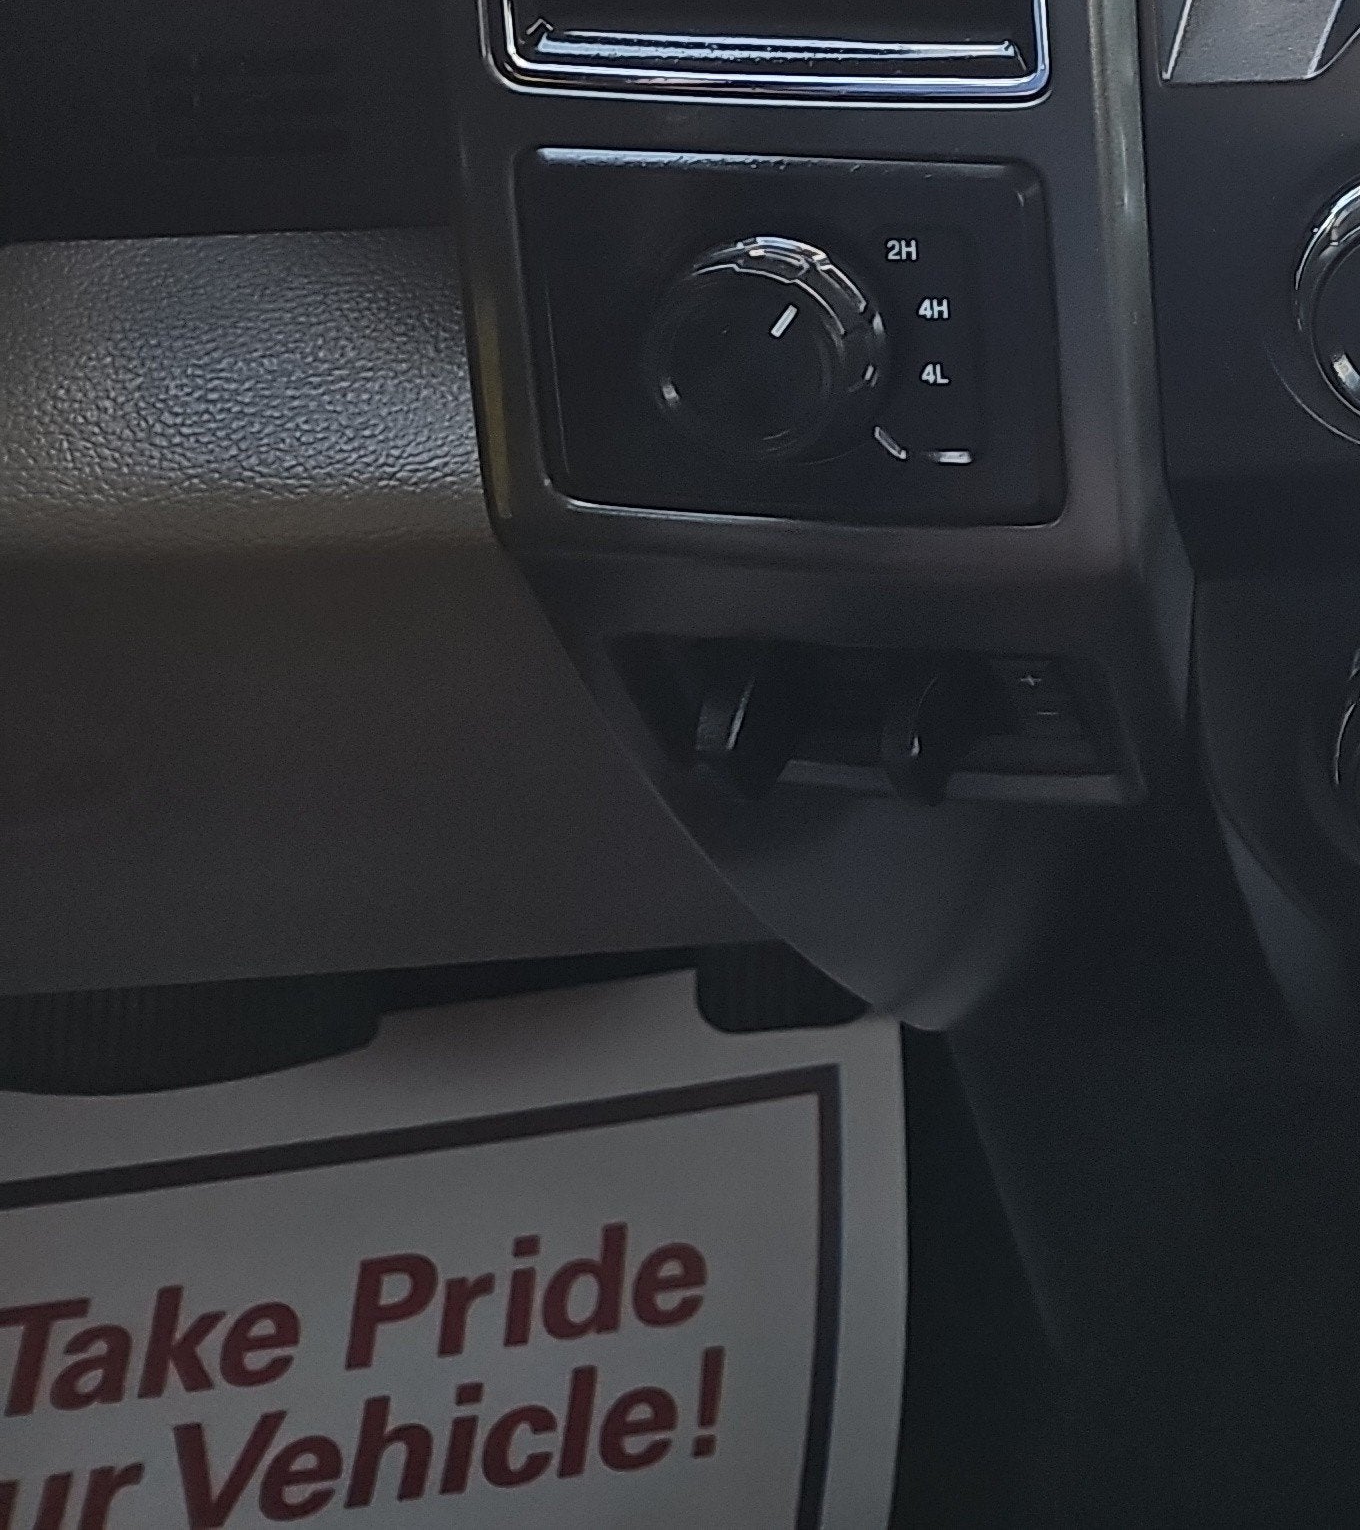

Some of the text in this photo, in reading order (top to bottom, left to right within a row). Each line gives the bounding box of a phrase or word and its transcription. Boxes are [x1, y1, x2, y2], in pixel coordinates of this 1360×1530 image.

[887, 240, 916, 260] 2H
[919, 299, 948, 318] 4H
[922, 364, 948, 383] 4L
[0, 1221, 708, 1416] Take Pride
[0, 1346, 725, 1530] ur Vehicle!
